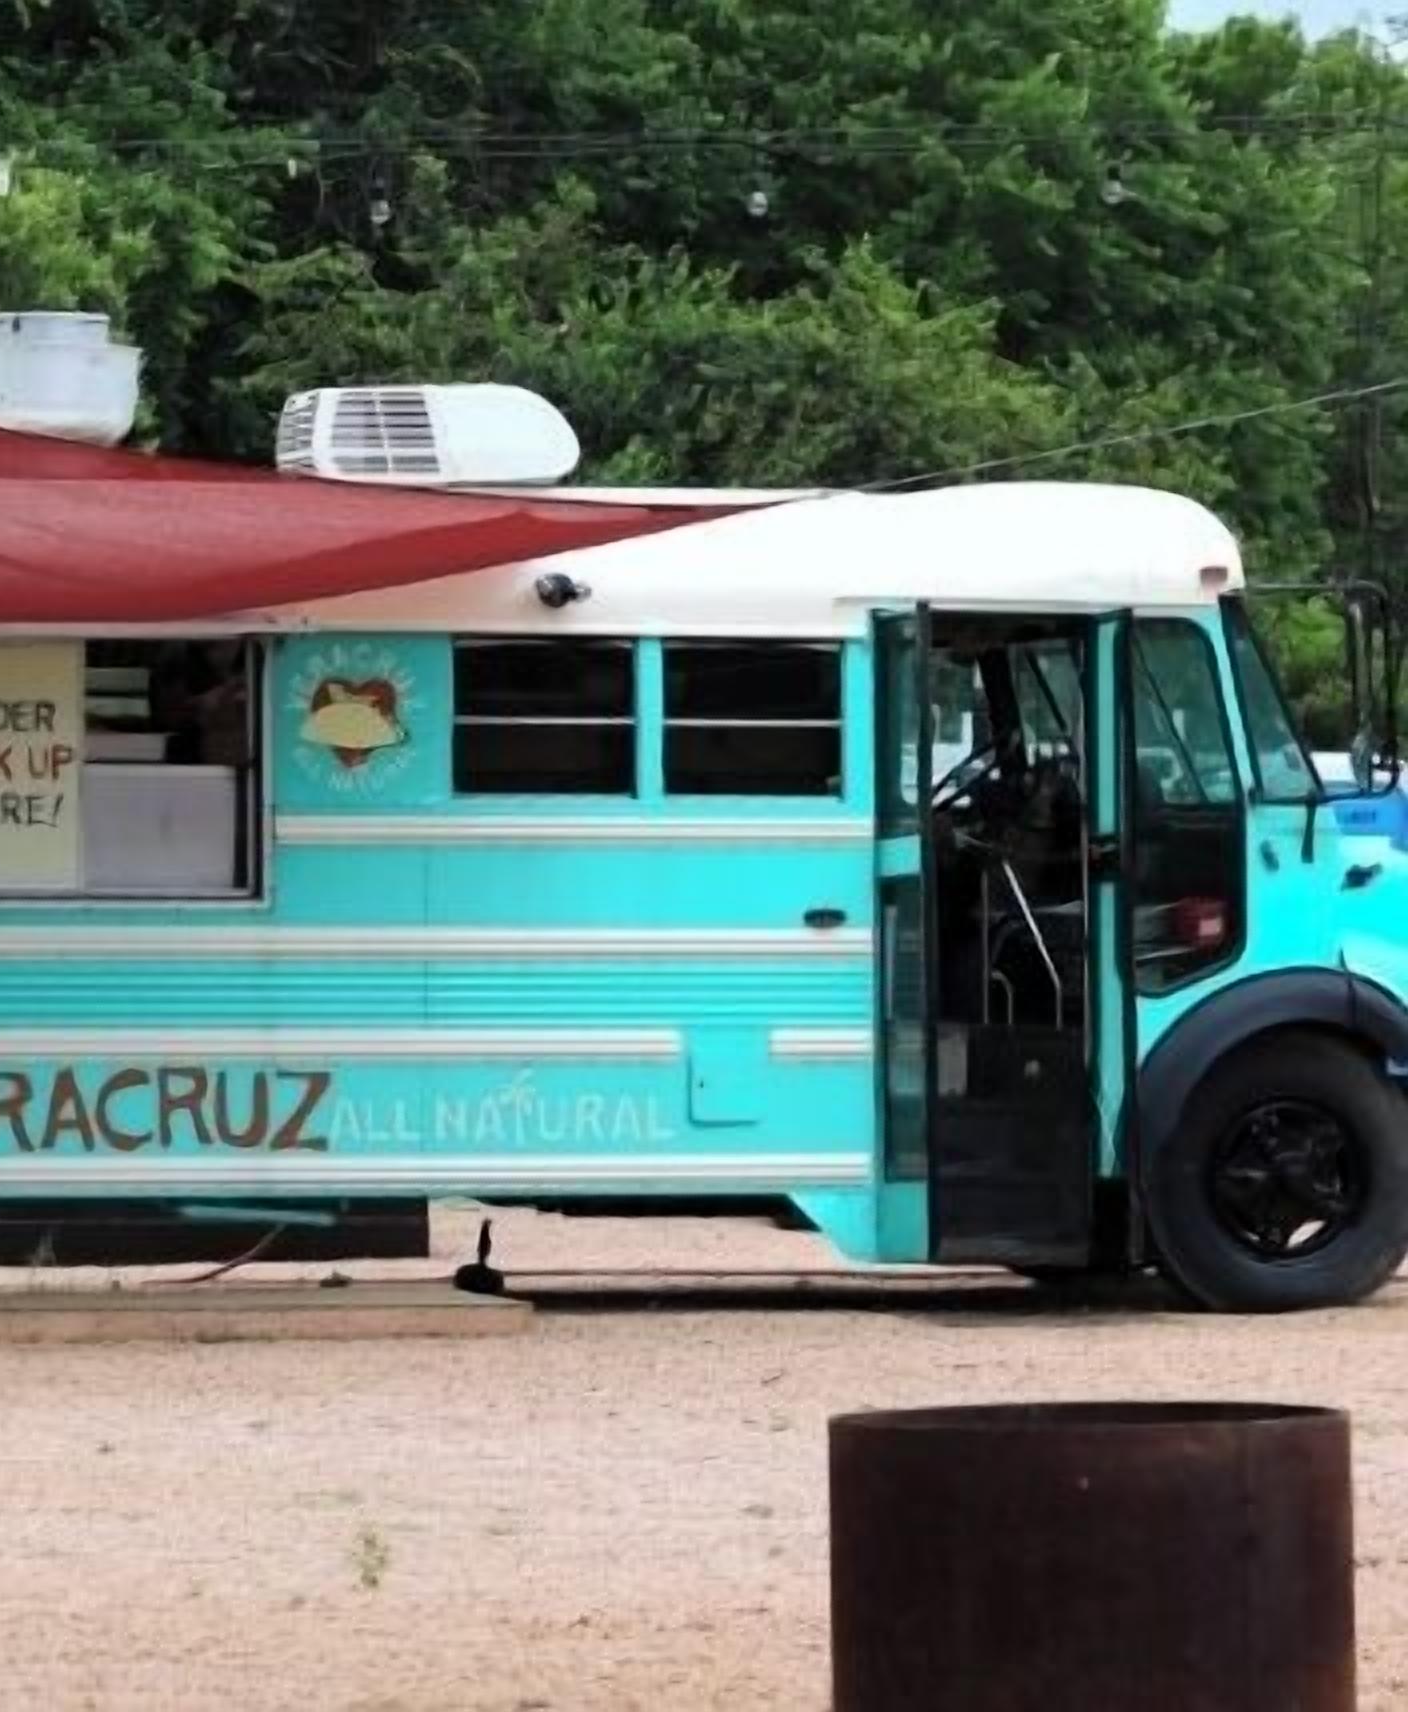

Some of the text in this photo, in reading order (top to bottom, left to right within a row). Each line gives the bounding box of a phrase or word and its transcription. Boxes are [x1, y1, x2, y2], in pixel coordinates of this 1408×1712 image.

[28, 745, 74, 780] UP
[329, 1096, 421, 1141] ALL
[436, 1090, 678, 1145] NATURAL
